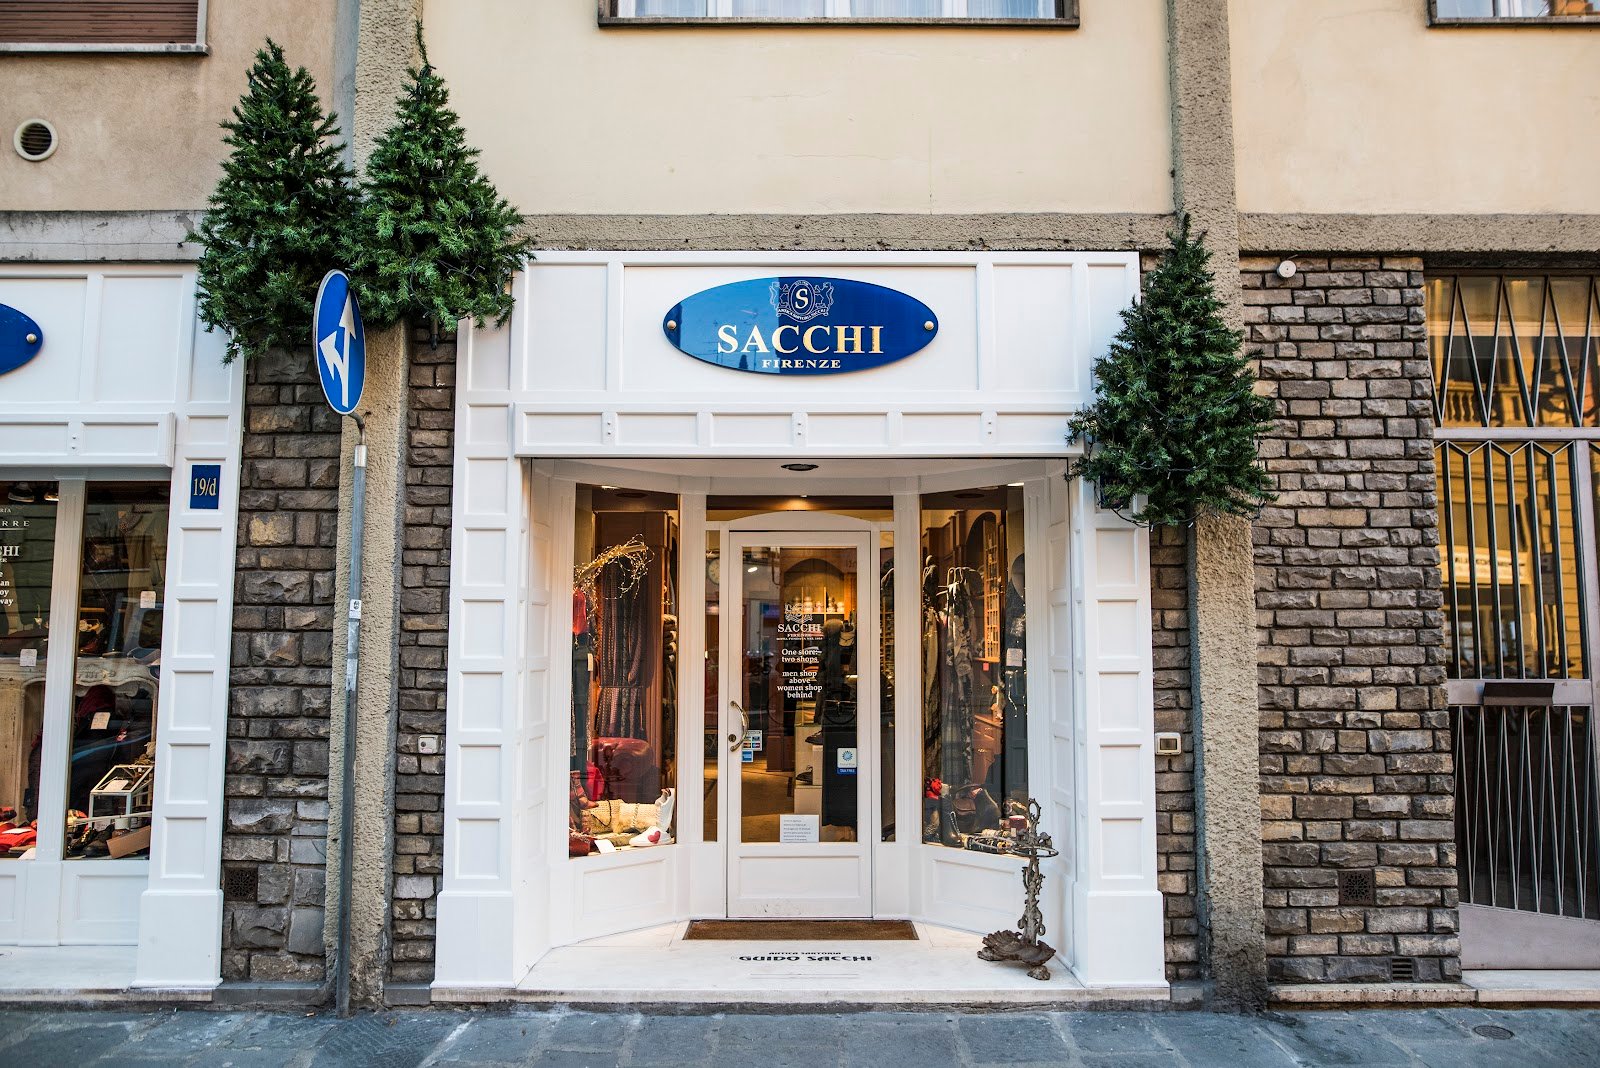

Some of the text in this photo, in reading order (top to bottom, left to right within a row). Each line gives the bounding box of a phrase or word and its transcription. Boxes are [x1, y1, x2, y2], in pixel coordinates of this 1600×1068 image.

[795, 288, 809, 309] S
[717, 325, 884, 354] SACCHI
[762, 359, 841, 369] FIRENZE
[193, 477, 217, 496] 19/d
[777, 623, 821, 633] SACCHI
[781, 648, 797, 656] One
[800, 670, 818, 679] shop
[805, 684, 823, 692] shop
[787, 691, 813, 699] behind
